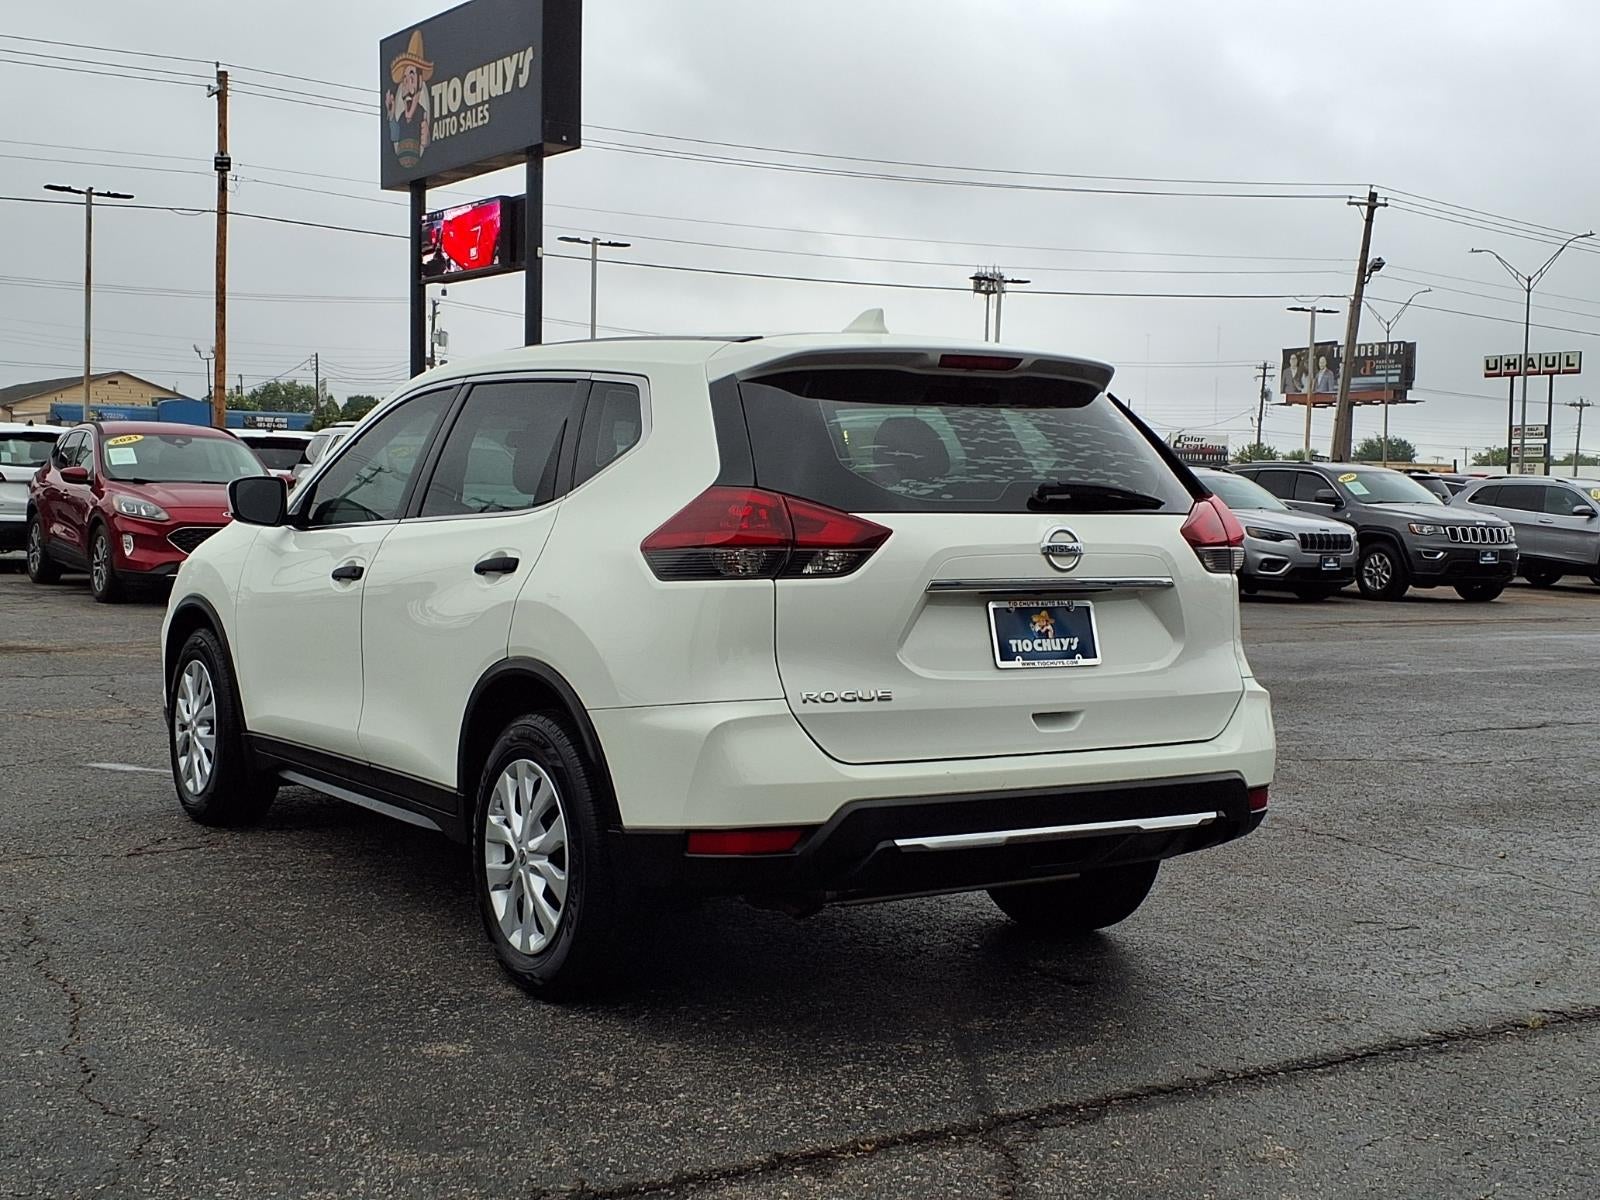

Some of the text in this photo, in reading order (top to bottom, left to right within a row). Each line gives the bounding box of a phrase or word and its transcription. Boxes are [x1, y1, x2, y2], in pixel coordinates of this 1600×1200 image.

[431, 46, 534, 118] TIO CHUY'S
[431, 103, 490, 141] AUTO SALES
[1173, 440, 1227, 450] Creations
[1178, 435, 1206, 443] Color
[1046, 544, 1082, 553] NISSAN
[800, 689, 893, 704] ROGUE
